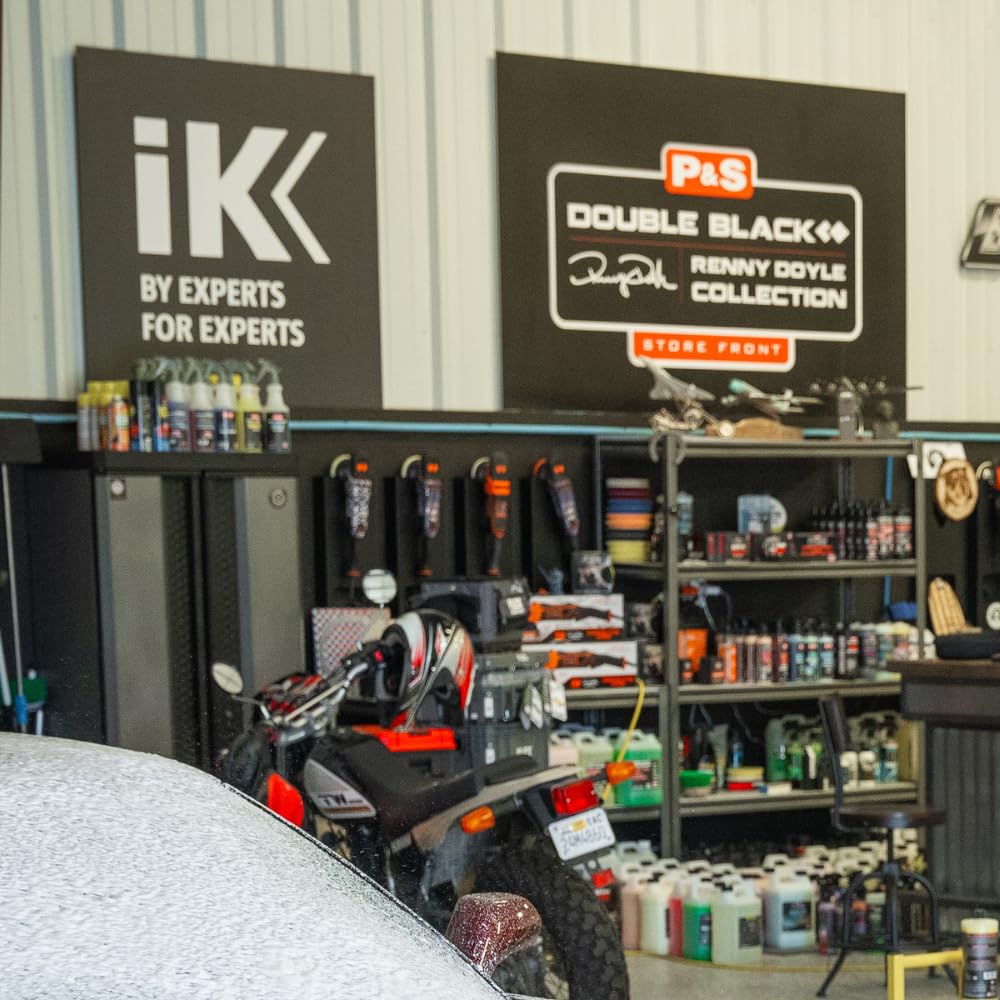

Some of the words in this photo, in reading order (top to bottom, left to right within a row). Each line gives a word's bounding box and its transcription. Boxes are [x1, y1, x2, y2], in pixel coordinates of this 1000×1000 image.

[671, 154, 748, 194] P&S
[566, 202, 698, 236] DOUBLE
[708, 212, 815, 243] BLACK
[690, 255, 769, 279] RENNY
[773, 262, 847, 282] DOYLE
[140, 273, 172, 303] BY
[179, 276, 286, 309] EXPERTS
[691, 282, 848, 309] COLLECTION
[142, 312, 193, 344] FOR
[199, 316, 305, 348] EXPERTS
[642, 338, 707, 353] STORE
[717, 343, 782, 357] FRONT
